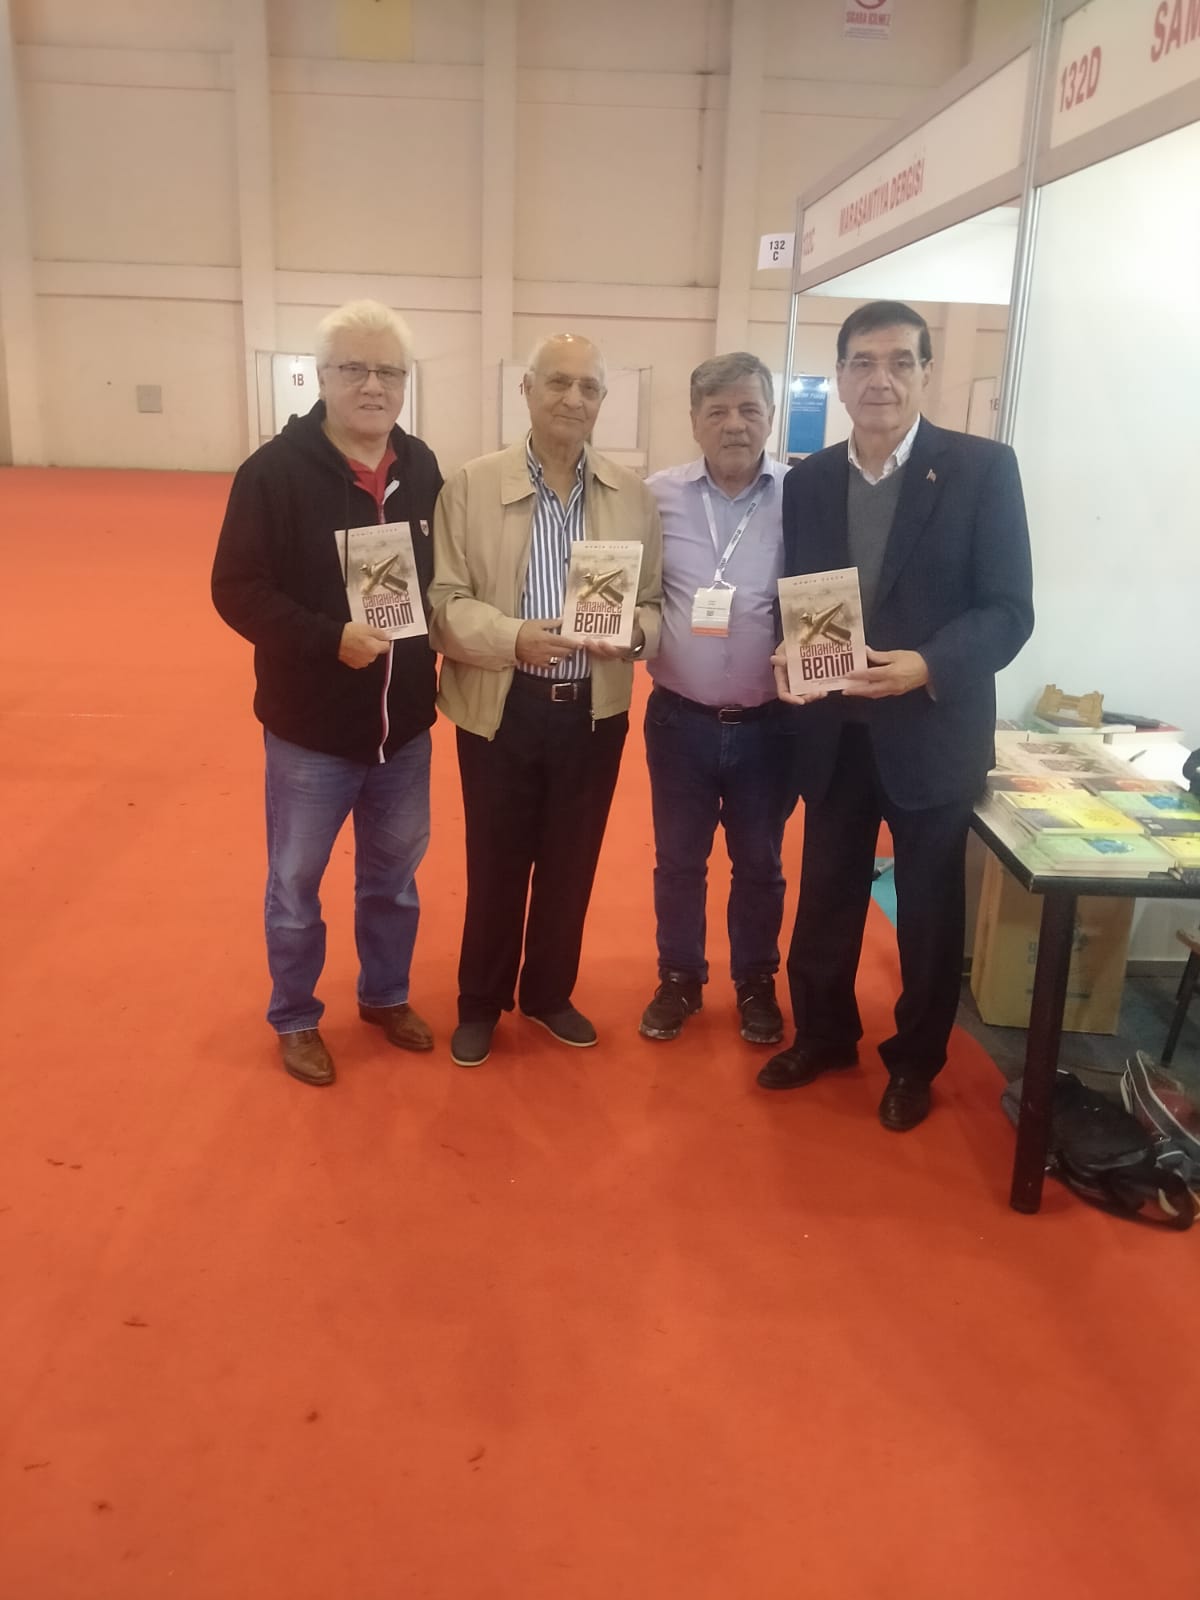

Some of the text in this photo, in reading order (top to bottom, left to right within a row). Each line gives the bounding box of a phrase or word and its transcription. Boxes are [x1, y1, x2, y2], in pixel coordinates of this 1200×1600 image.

[1059, 45, 1102, 112] 132D
[769, 240, 786, 251] 132
[772, 251, 779, 261] C
[292, 373, 304, 386] 1B
